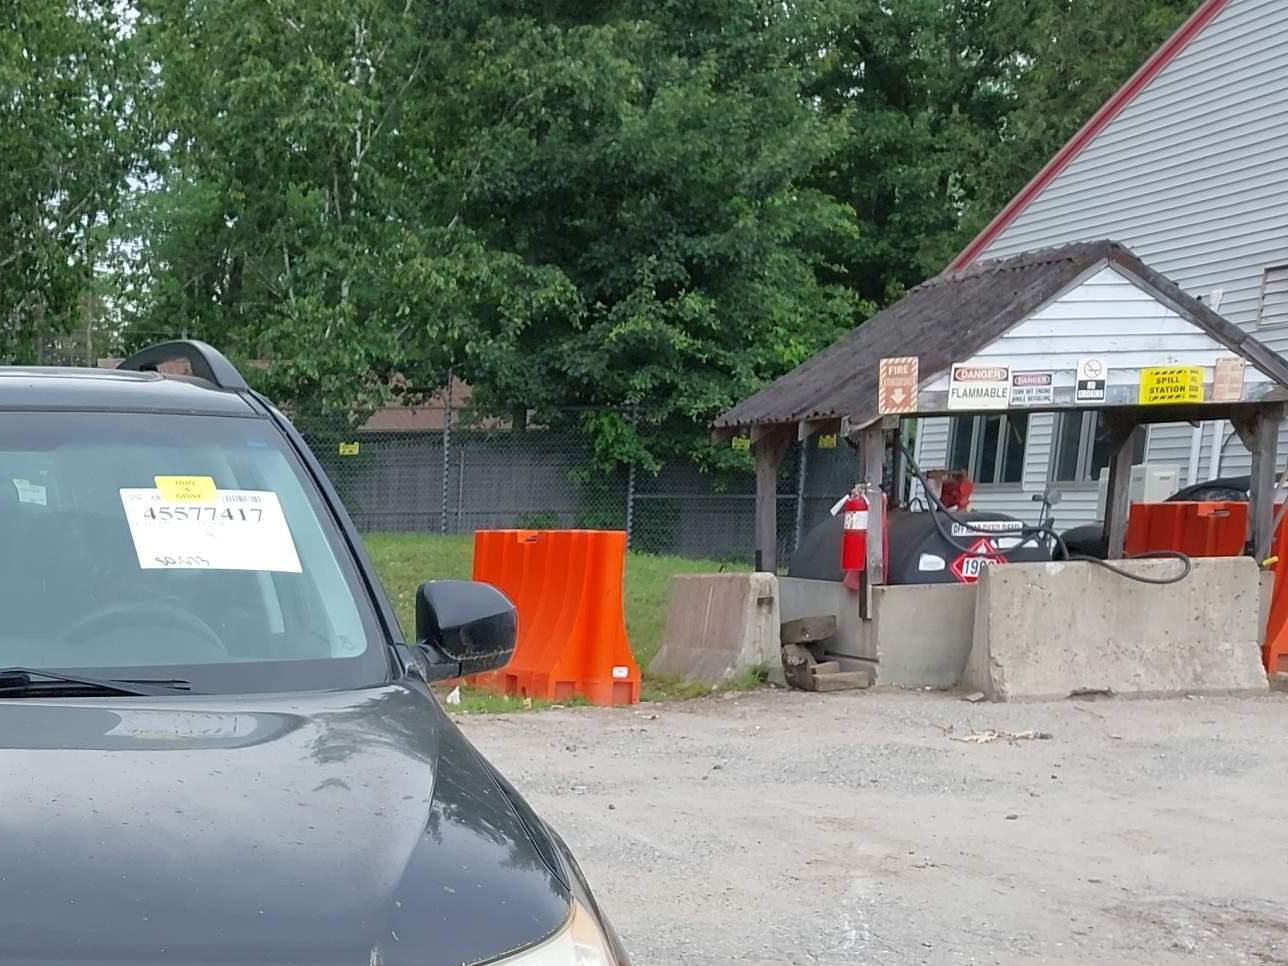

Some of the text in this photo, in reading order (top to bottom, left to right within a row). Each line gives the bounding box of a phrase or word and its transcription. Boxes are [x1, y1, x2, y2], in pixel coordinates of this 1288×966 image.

[888, 365, 909, 375] FIRE
[961, 368, 1001, 379] DANGER
[1017, 375, 1048, 384] DANGER
[1155, 376, 1180, 385] SPILL
[951, 387, 1008, 399] FLAMMABLE
[1149, 385, 1186, 394] STATION
[143, 506, 264, 522] 45577417
